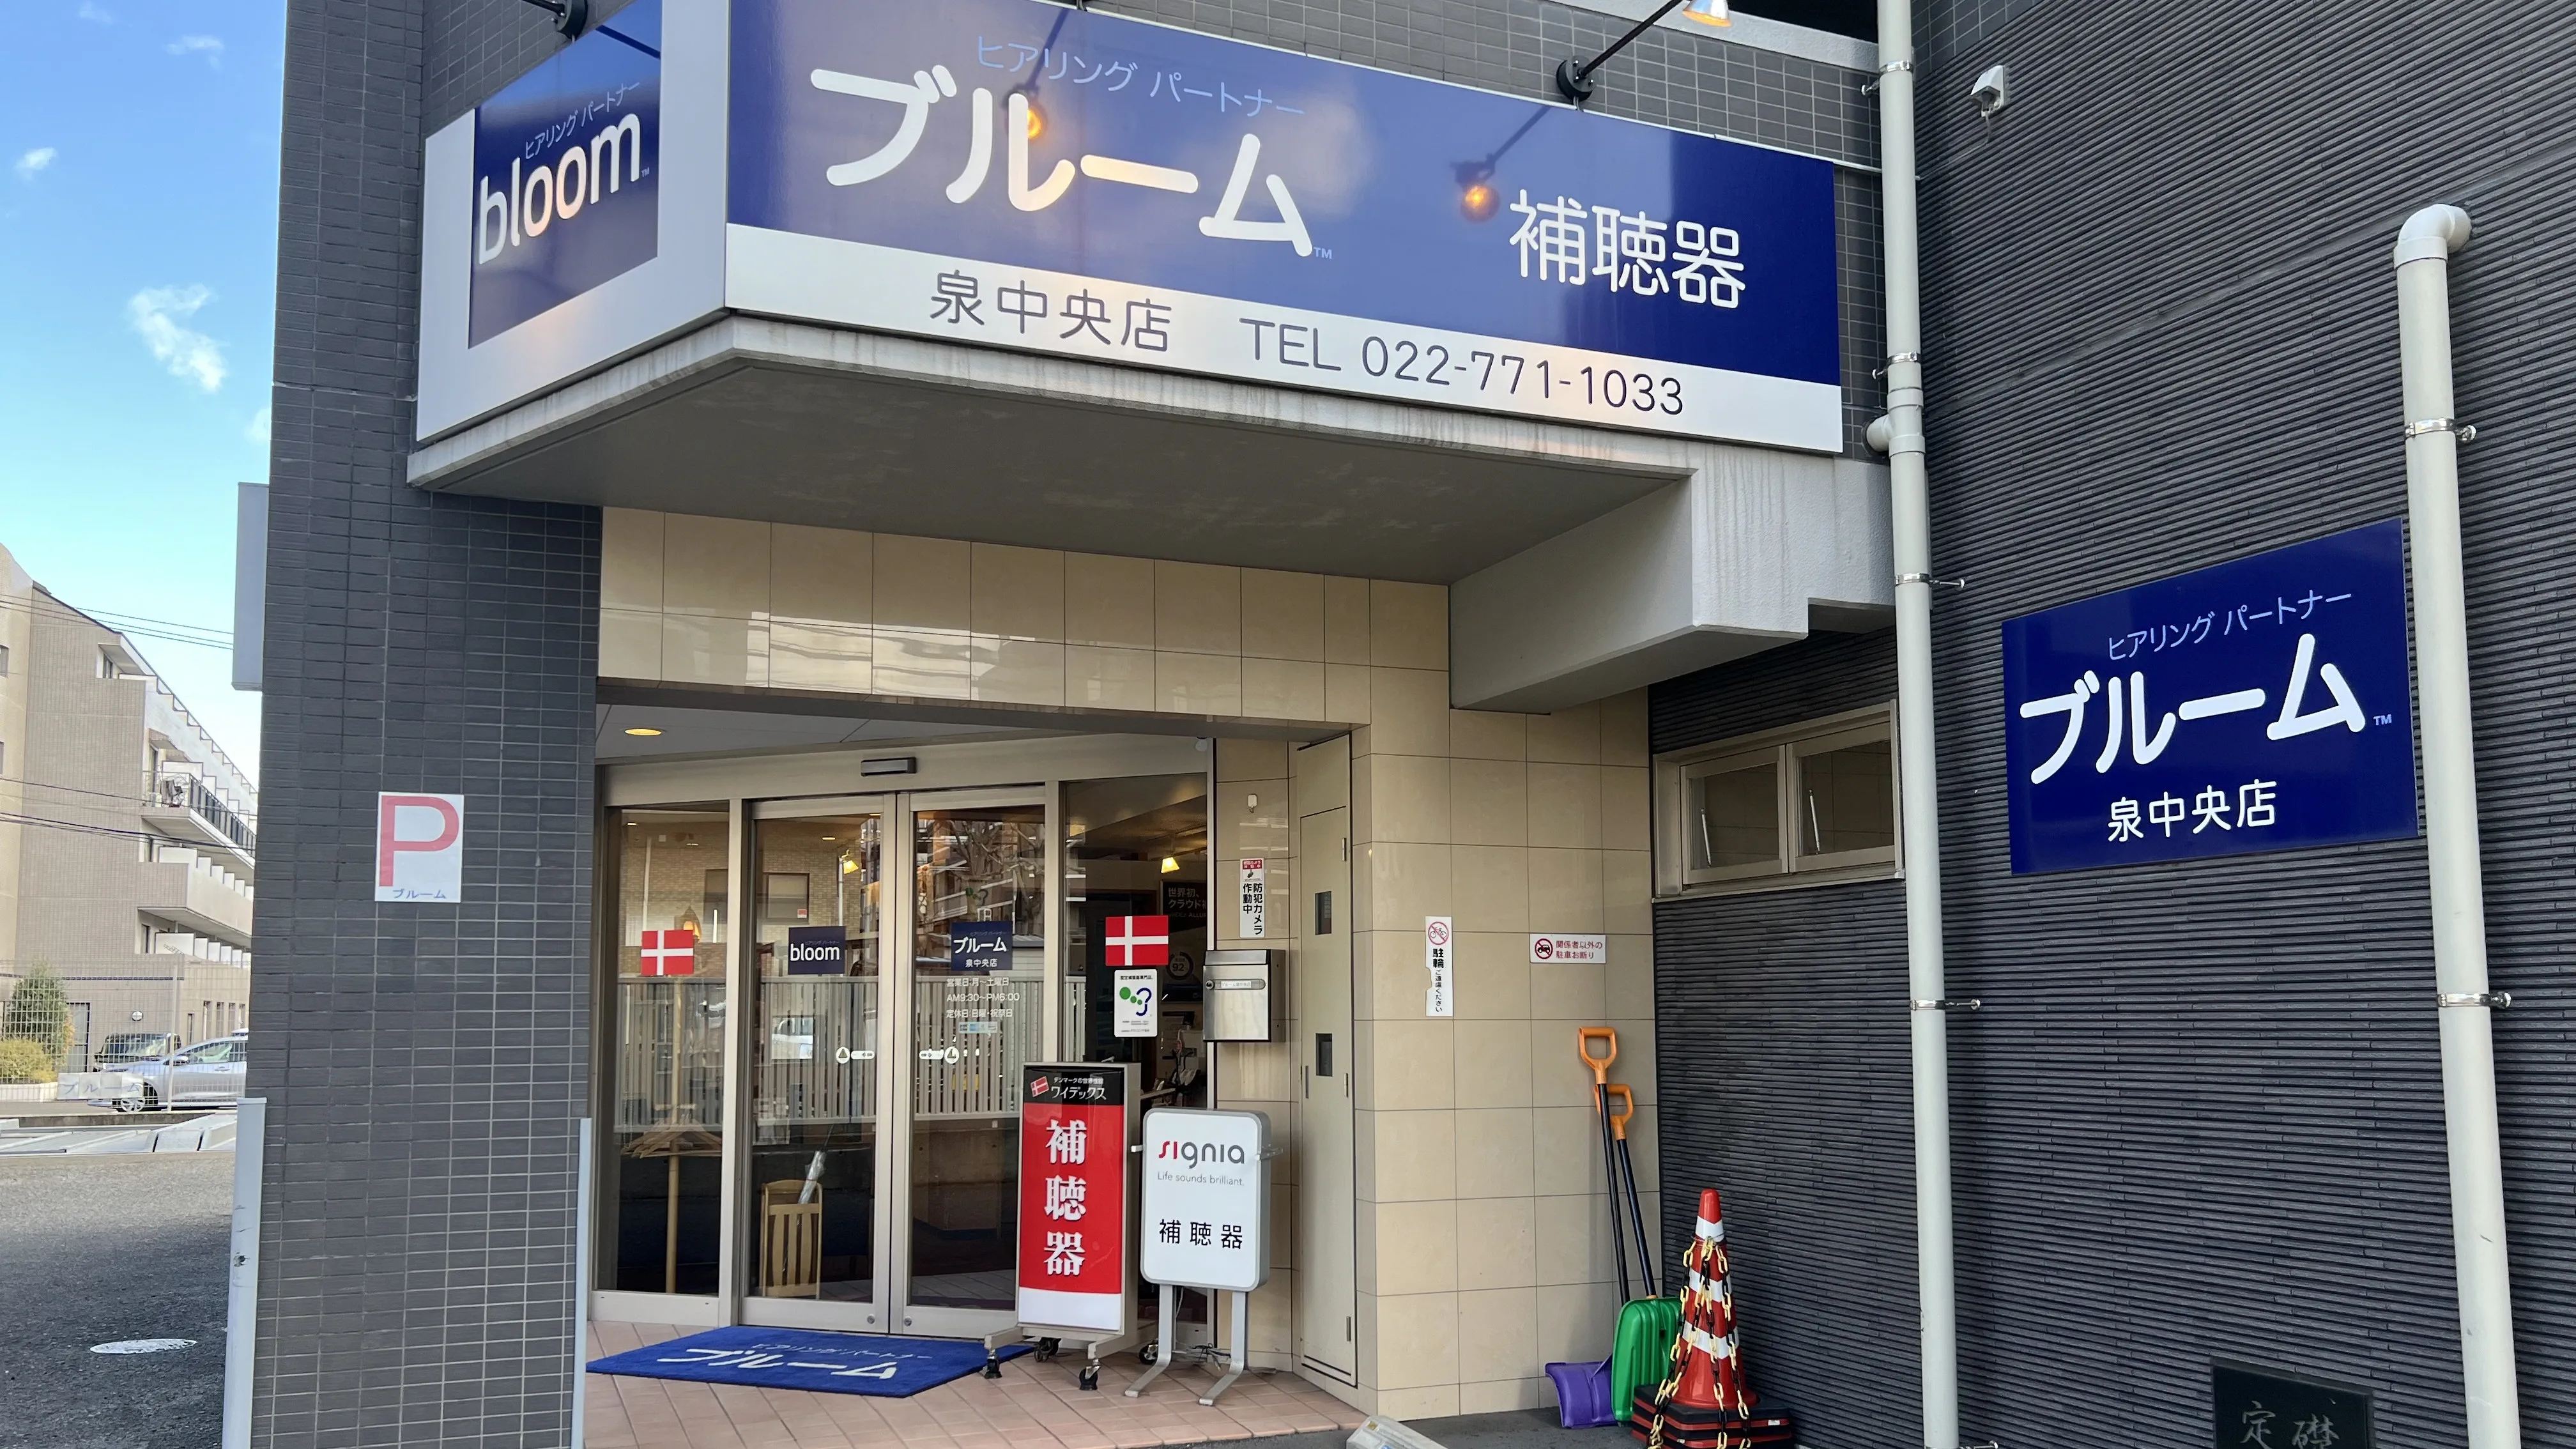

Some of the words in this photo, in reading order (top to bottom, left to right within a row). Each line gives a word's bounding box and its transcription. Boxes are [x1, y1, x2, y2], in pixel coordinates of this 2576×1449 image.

[978, 36, 1139, 92] ヒアリング
[1150, 71, 1305, 118] パートナー
[525, 109, 579, 160] ヒアリング
[581, 82, 640, 127] パートナー
[810, 64, 1313, 257] ブルーム
[479, 112, 641, 265] bloom
[1508, 188, 1746, 310] 補聴器
[930, 269, 1173, 353] 泉中央店
[1239, 317, 1342, 372] TEL
[1361, 335, 1684, 417] 022-771-1033
[2108, 611, 2216, 661] ヒアリング
[2224, 589, 2352, 636] パートナー
[2020, 632, 2366, 785] ブルーム
[2108, 778, 2278, 843] 泉中央店
[379, 795, 460, 887] P
[392, 888, 448, 900] ブルーム
[1243, 883, 1252, 914] 作動中
[1253, 882, 1263, 935] 防犯カメラ
[790, 943, 840, 962] bloom
[953, 936, 1007, 954] ブルーム
[1555, 940, 1603, 949] 関係者以外の
[1556, 951, 1594, 959] 駐車お断り
[965, 958, 997, 968] 泉中央店
[61, 1081, 141, 1095] ブルーム
[1050, 1085, 1107, 1100] ワイデックス
[1158, 1140, 1245, 1170] signia
[1157, 1170, 1174, 1181] Life
[1176, 1173, 1207, 1184] sounds
[1209, 1174, 1245, 1186] brilliant.
[1043, 1119, 1087, 1276] 補聴器
[1159, 1218, 1243, 1250] 補聴器
[656, 1348, 898, 1379] ブルーム
